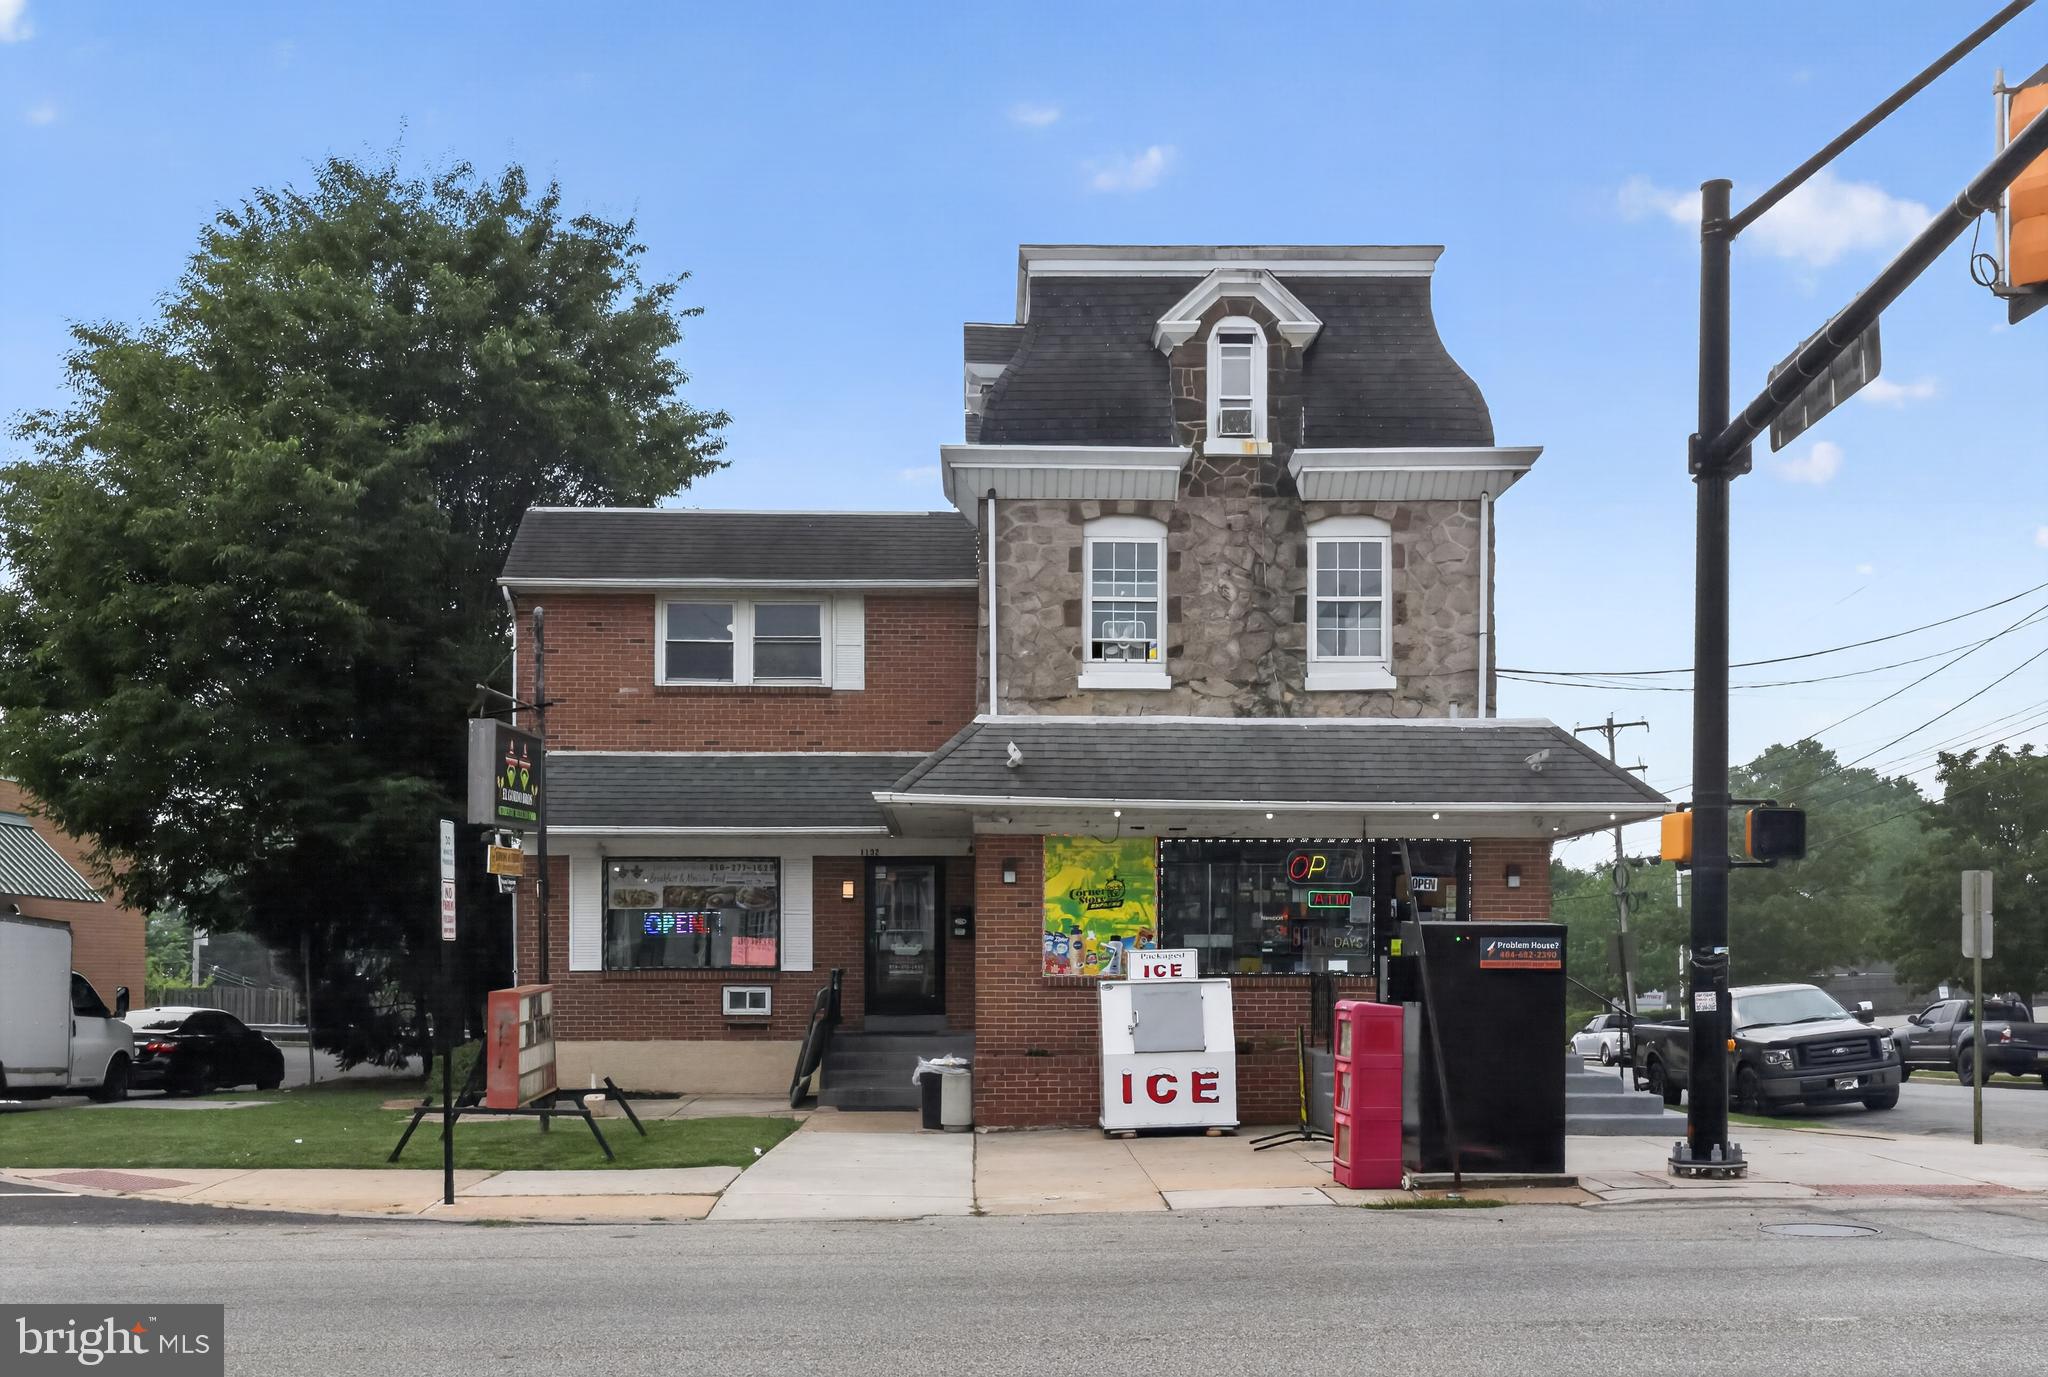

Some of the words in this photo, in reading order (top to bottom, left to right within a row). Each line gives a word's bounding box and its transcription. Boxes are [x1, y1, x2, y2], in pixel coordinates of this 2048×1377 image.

[1290, 855, 1361, 879] OPEN
[1413, 878, 1436, 890] OPEN
[1069, 888, 1105, 901] Corner
[1314, 893, 1349, 905] ATM
[644, 914, 707, 935] OPEN
[1344, 925, 1354, 936] 7
[1333, 937, 1363, 949] DAYS
[1497, 941, 1530, 949] Problem
[1531, 941, 1559, 949] House?
[1140, 952, 1185, 960] Packaged
[1144, 963, 1182, 977] ICE
[1121, 1067, 1219, 1104] ICE
